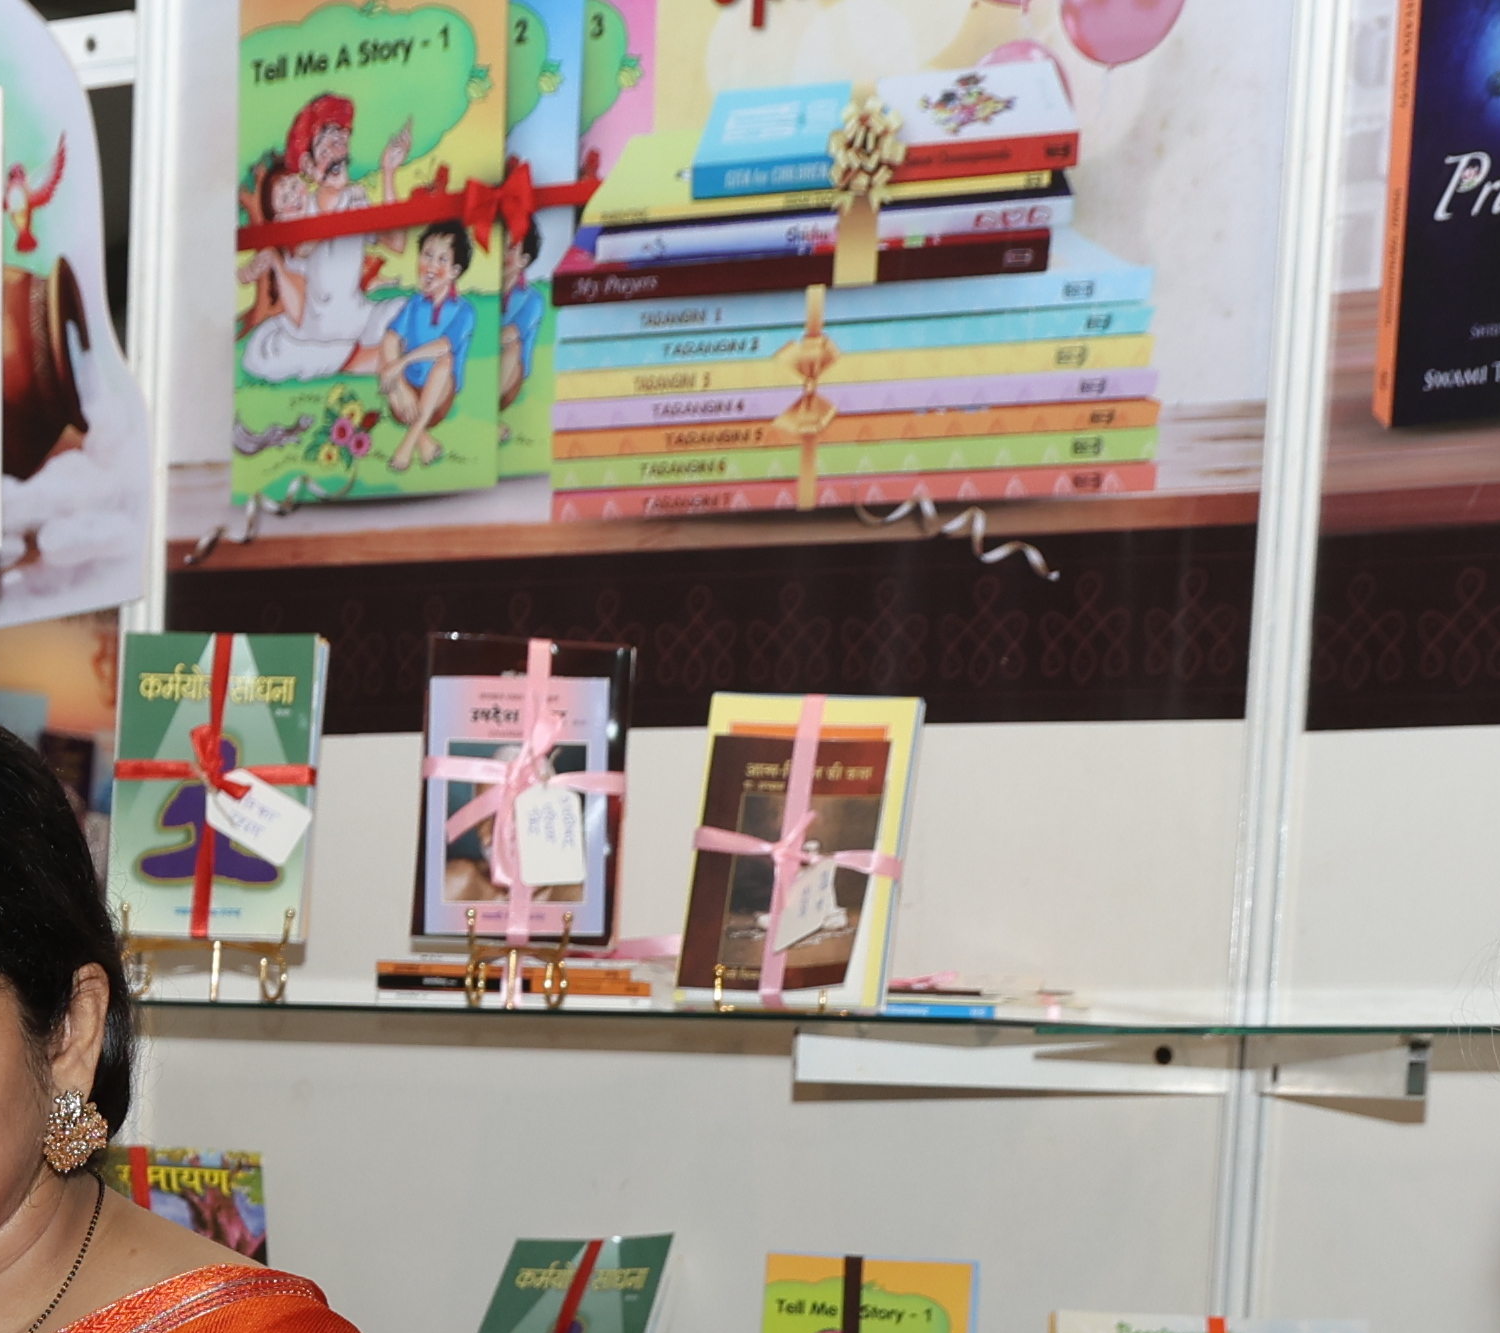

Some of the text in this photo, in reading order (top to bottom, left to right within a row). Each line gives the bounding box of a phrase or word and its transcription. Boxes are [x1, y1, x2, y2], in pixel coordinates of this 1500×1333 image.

[513, 18, 530, 45] 2
[588, 14, 605, 42] 3
[252, 24, 451, 86] Tell Me A Story 1
[602, 274, 659, 299] Prayers
[1421, 364, 1489, 392] SWAMI
[138, 661, 215, 704] कर्मयो
[115, 1163, 233, 1197] रमायण
[775, 1298, 933, 1325] Tell Me Story 1
